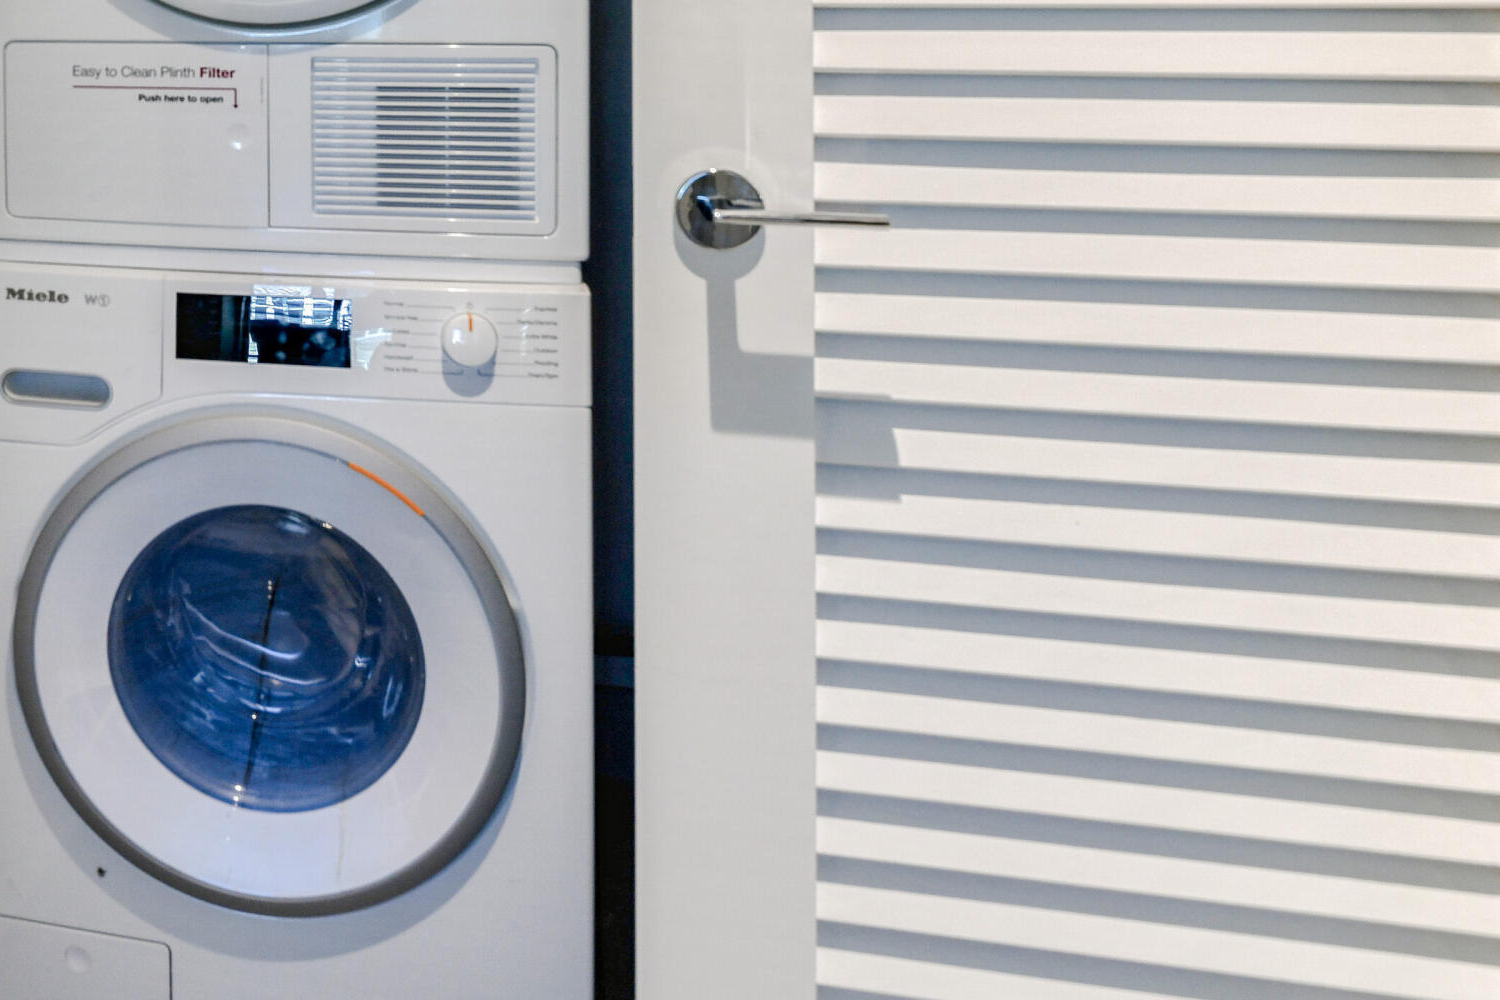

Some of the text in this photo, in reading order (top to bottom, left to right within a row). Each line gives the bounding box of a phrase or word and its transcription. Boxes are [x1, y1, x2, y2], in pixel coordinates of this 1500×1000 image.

[72, 65, 236, 79] Easy to Clean Plinth Filter
[138, 93, 224, 104] Push here to open
[5, 287, 69, 304] Miele
